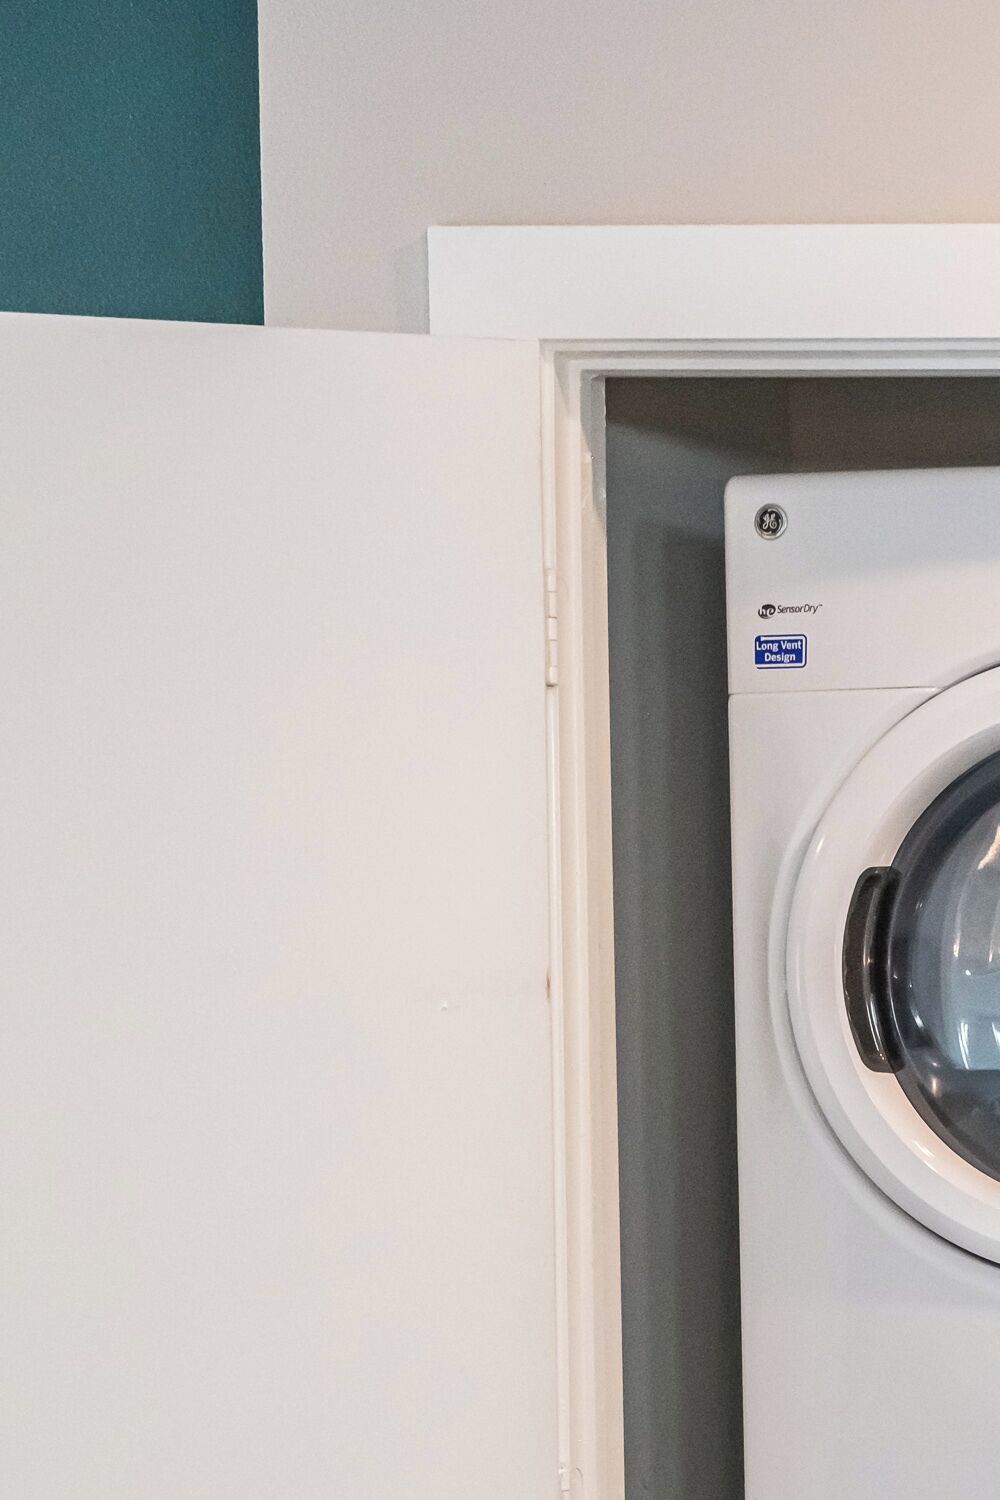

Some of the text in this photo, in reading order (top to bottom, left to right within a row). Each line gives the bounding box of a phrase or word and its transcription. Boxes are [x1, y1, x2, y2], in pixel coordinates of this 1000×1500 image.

[756, 640, 802, 652] Long Vent
[764, 652, 796, 663] Design
